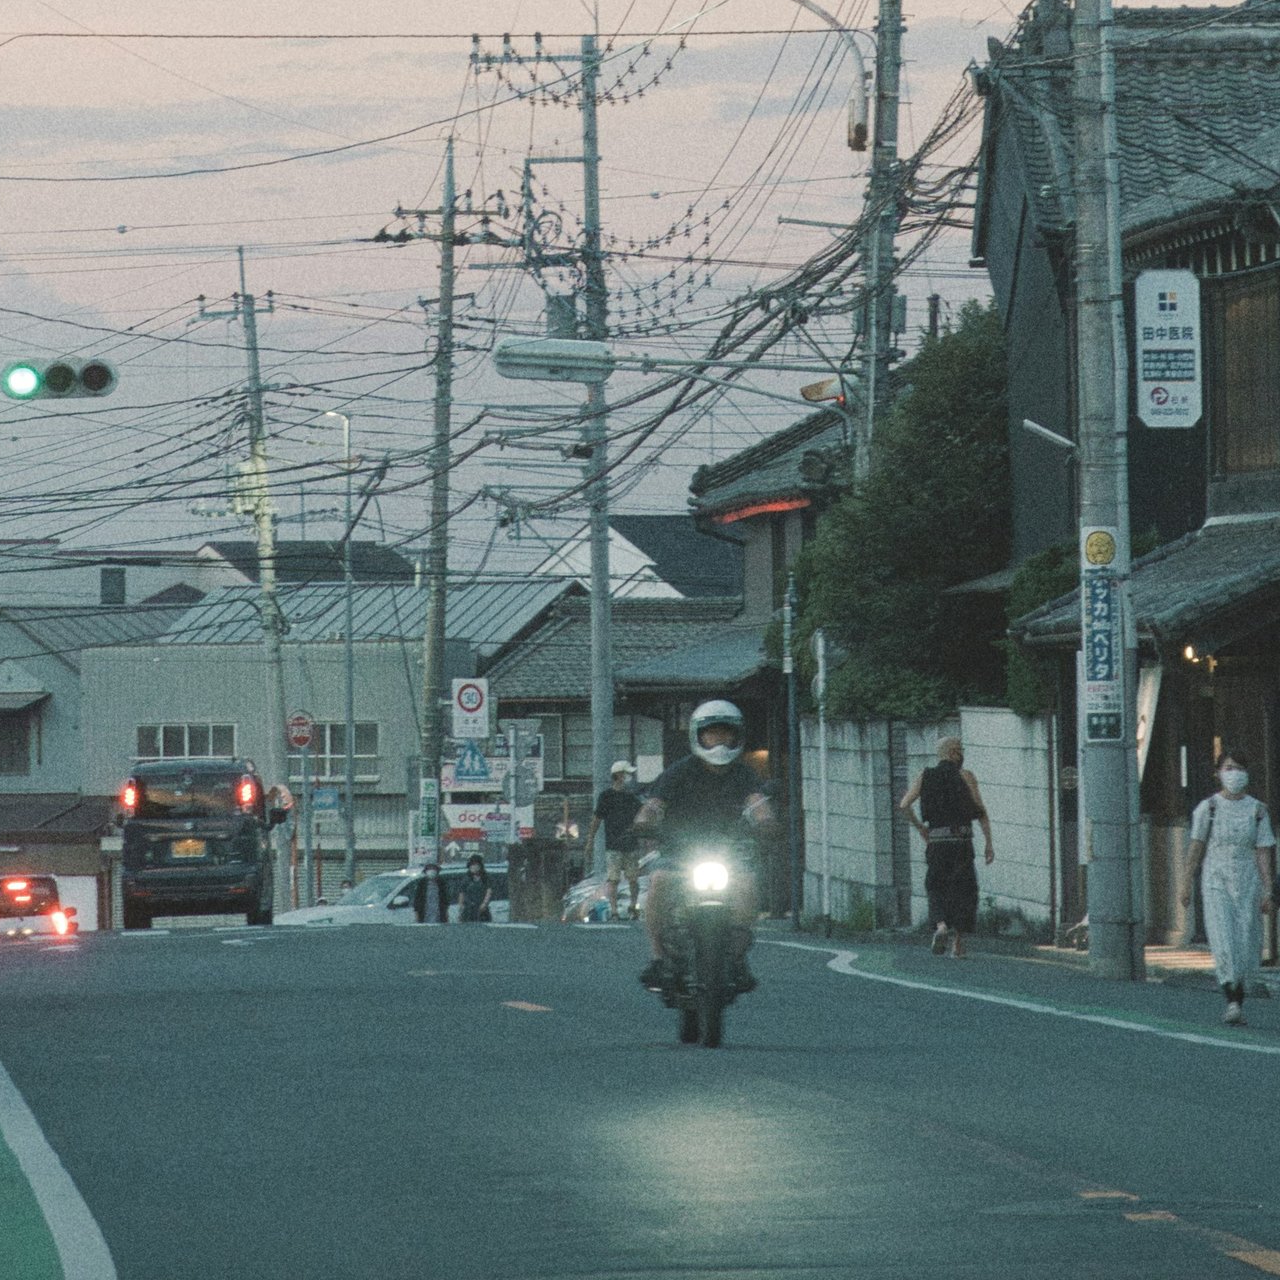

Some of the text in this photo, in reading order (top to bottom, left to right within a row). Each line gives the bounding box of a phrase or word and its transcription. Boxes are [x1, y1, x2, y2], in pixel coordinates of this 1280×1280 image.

[1142, 326, 1195, 341] 田中医院
[463, 691, 478, 705] 30
